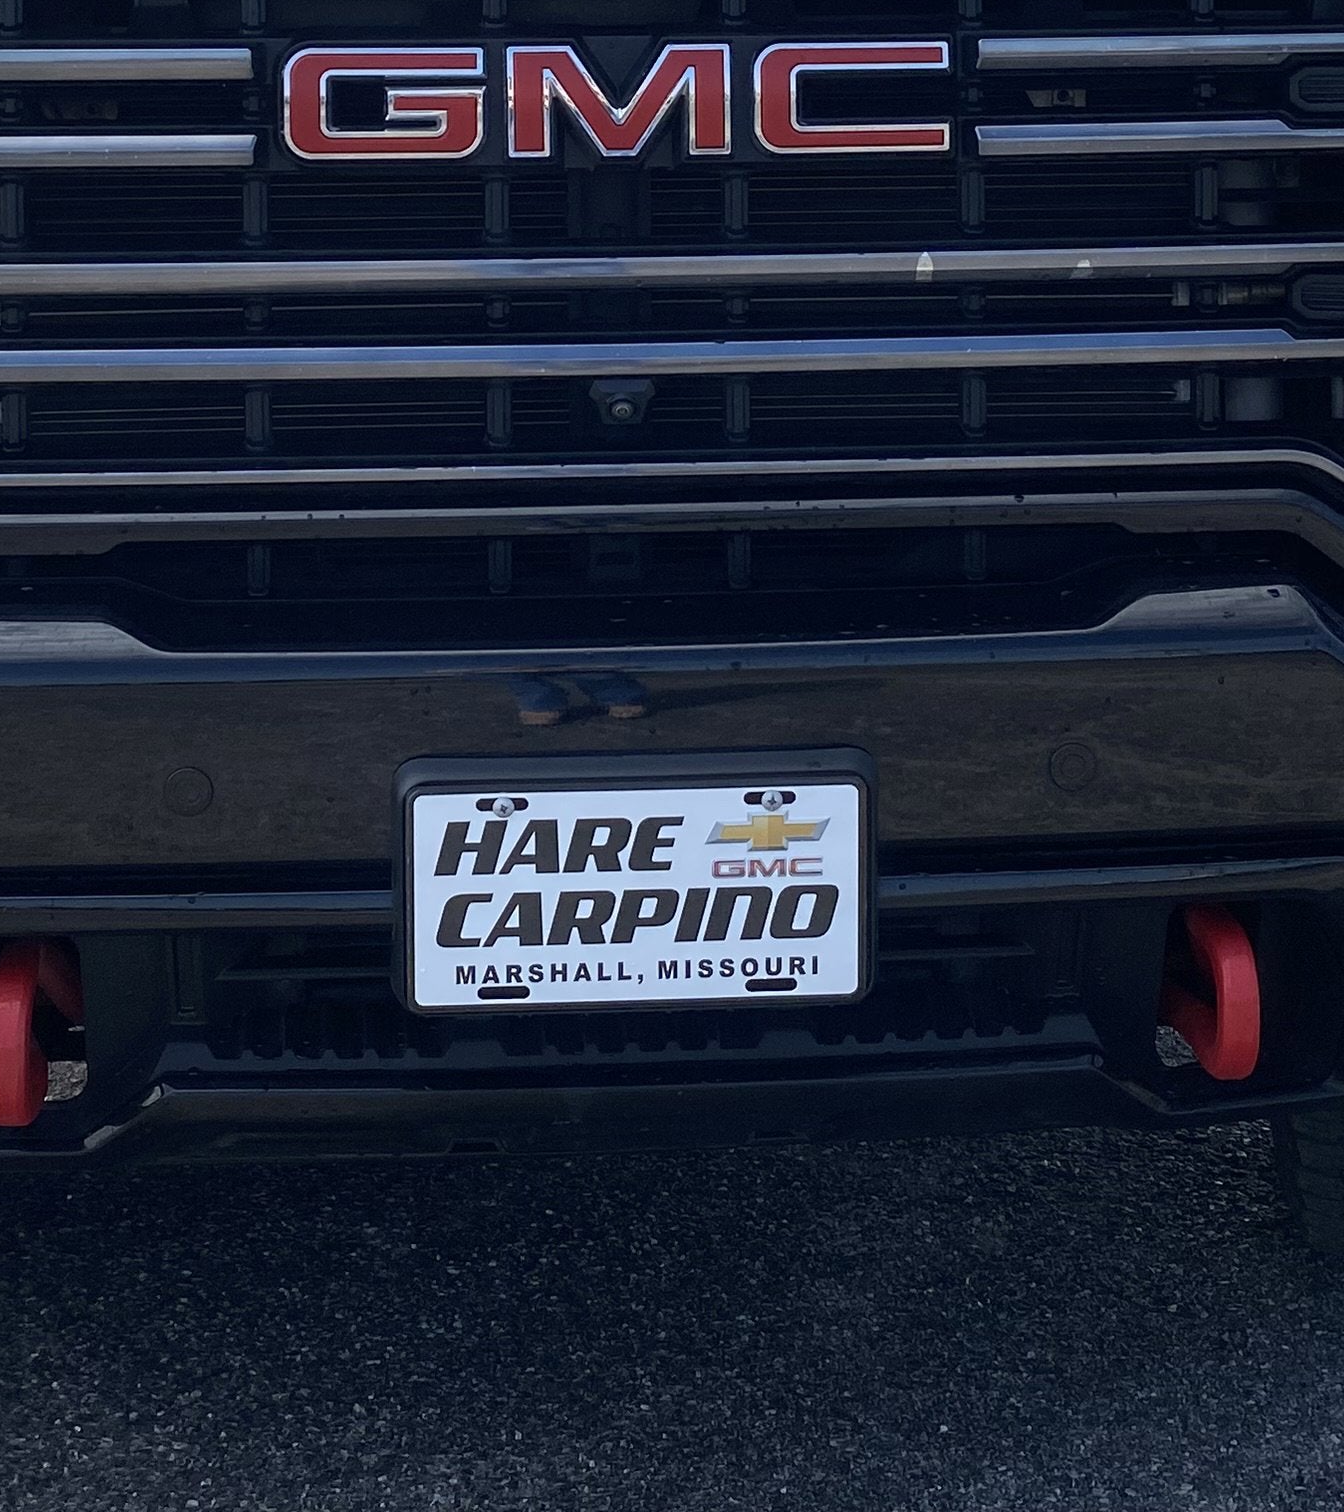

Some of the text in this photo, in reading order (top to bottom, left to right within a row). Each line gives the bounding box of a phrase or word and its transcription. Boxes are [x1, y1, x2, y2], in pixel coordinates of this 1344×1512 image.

[282, 41, 951, 160] GMC
[433, 815, 685, 877] HARE
[711, 856, 824, 880] GMC
[435, 884, 840, 948] CARPINO
[455, 955, 820, 986] MARSHALL, MISSOURI
